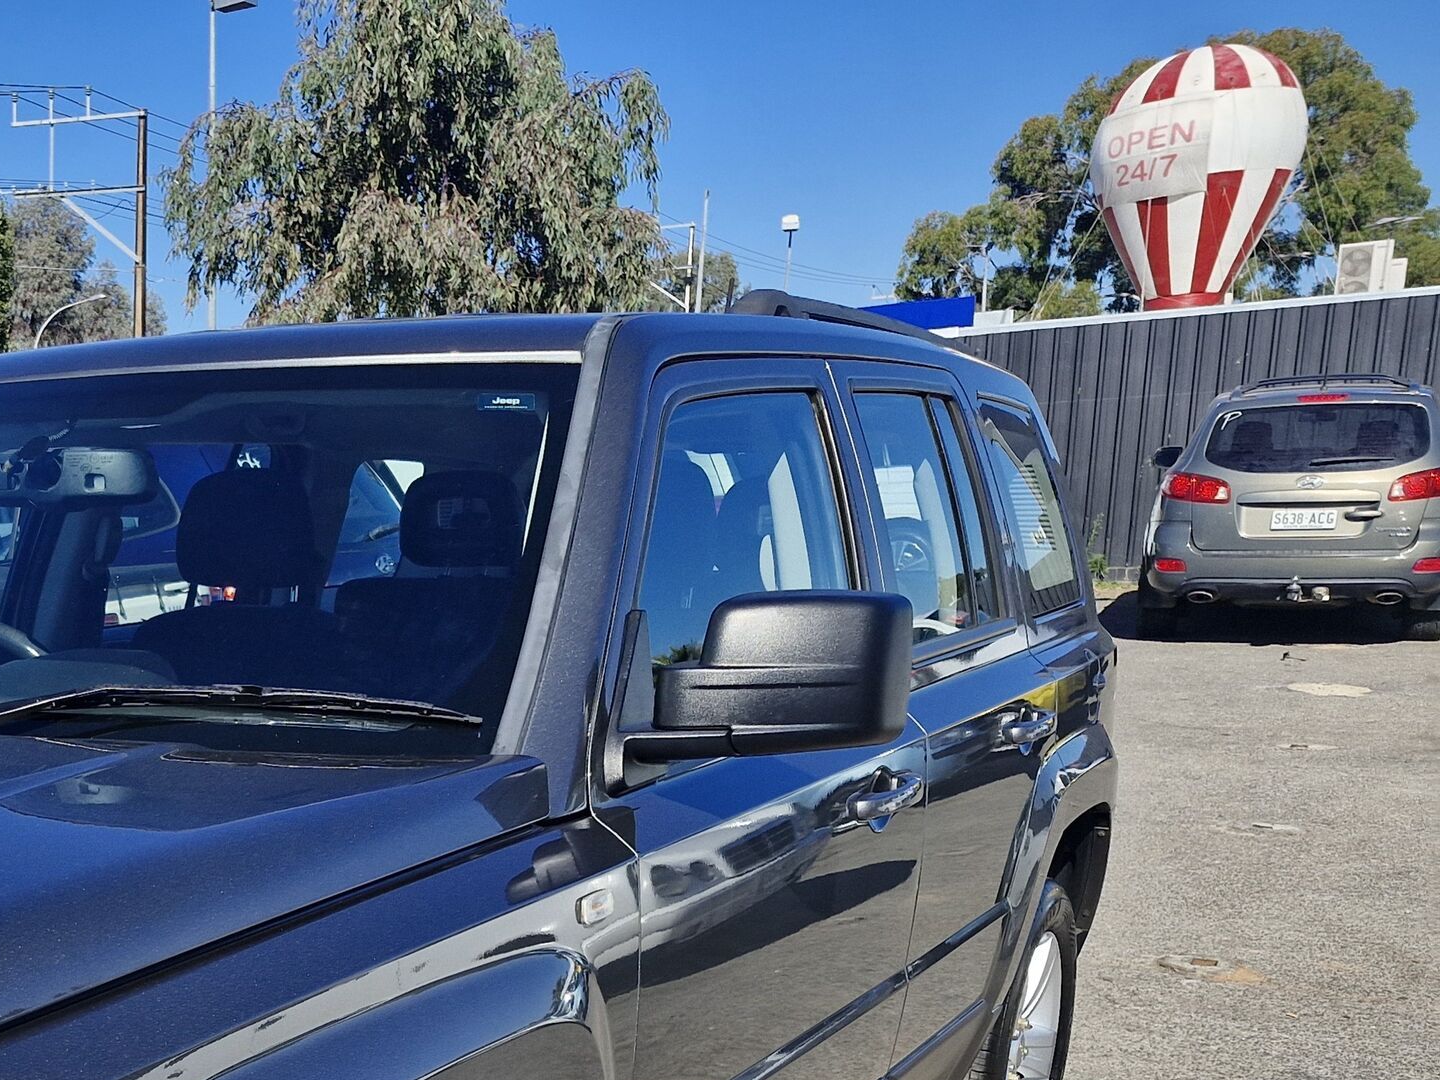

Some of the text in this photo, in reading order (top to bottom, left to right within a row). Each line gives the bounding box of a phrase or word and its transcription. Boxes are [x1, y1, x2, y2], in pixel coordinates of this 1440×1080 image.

[1108, 119, 1195, 159] OPEN
[1116, 153, 1178, 187] 24/7
[491, 396, 521, 406] Jeep
[1220, 411, 1243, 431] P
